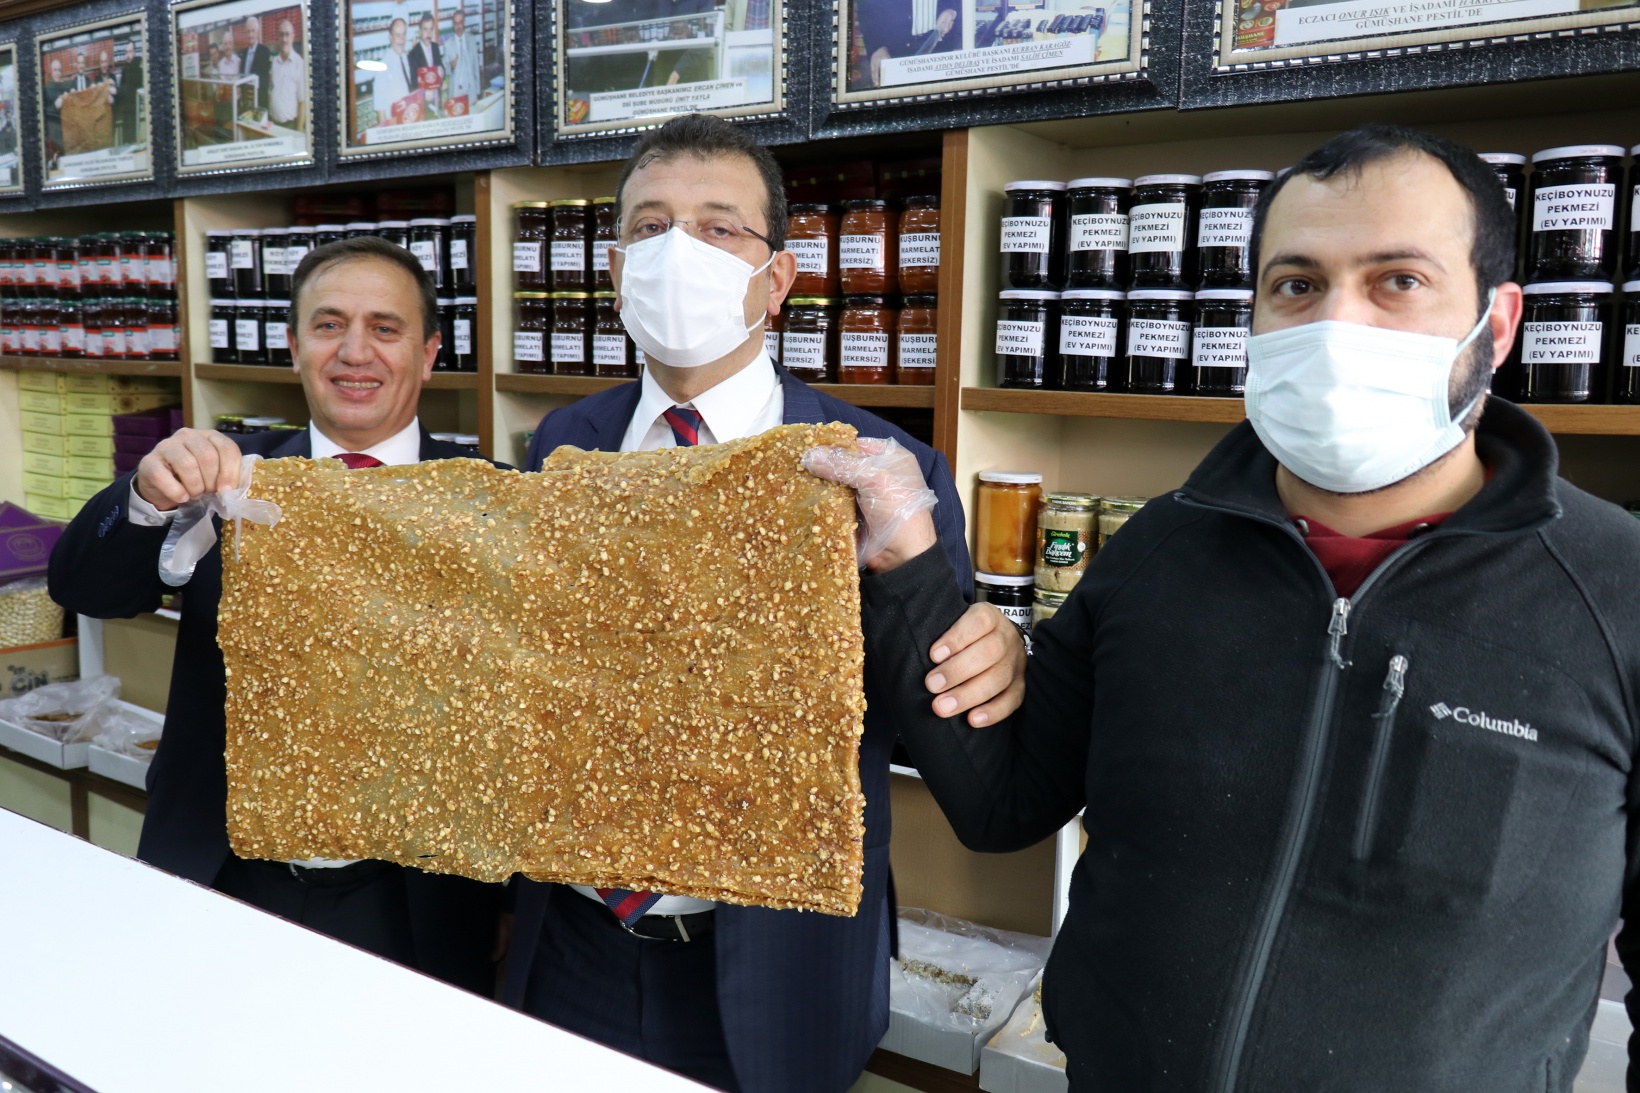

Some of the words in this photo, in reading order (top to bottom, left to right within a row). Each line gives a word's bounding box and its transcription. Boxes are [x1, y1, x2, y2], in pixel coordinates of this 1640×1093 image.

[1299, 14, 1336, 25] ECZACI
[1338, 10, 1367, 22] ONUR
[1393, 5, 1407, 14] VE
[1356, 15, 1424, 29] GÜMÜŞHANE
[1535, 186, 1614, 201] KEÇİBOYNUZU
[1547, 201, 1600, 214] PEKMEZİ
[1131, 211, 1183, 222] EÇİBOYNUZU
[1001, 219, 1049, 228] EÇİBOYNUZU
[1134, 222, 1169, 232] PEKMEZİ
[1204, 222, 1243, 231] PEKMEZİ
[1540, 218, 1559, 229] (EV
[1562, 216, 1606, 228] YAPIMI)
[1004, 230, 1037, 238] PEKMEZİ
[1083, 228, 1121, 236] PEKMEZİ
[1141, 235, 1177, 244] YAPIMI)
[1012, 242, 1045, 250] YAPIMI)
[1078, 240, 1091, 249] (EV
[1061, 318, 1117, 329] KEÇİBOYNUZU
[1130, 321, 1190, 331] KEÇİBOYNUZU
[1524, 321, 1601, 334] KEÇİBOYNUZU
[999, 334, 1029, 343] PEKMEZİ
[1068, 330, 1106, 339] PEKMEZİ
[1140, 333, 1180, 342] PEKMEZİ
[1194, 330, 1248, 339] KEÇİBOYNUZ
[901, 336, 937, 344] KUŞBUR
[1535, 334, 1587, 345] PEKMEZİ
[844, 345, 886, 353] MARMELATI
[1065, 341, 1077, 349] (EV
[1079, 342, 1113, 352] YAPIMI)
[1134, 344, 1148, 352] (EV
[1150, 345, 1185, 355] YAPIMI)
[1201, 341, 1242, 350] PEKMEZİ
[1005, 346, 1036, 355] YAPIMI)
[1529, 350, 1547, 360] (EV
[1550, 349, 1594, 360] YAPIMI)
[1197, 354, 1209, 363] (EV
[1212, 354, 1246, 362] YAPIMI
[999, 608, 1032, 617] RADU
[1453, 706, 1538, 742] Columbia
